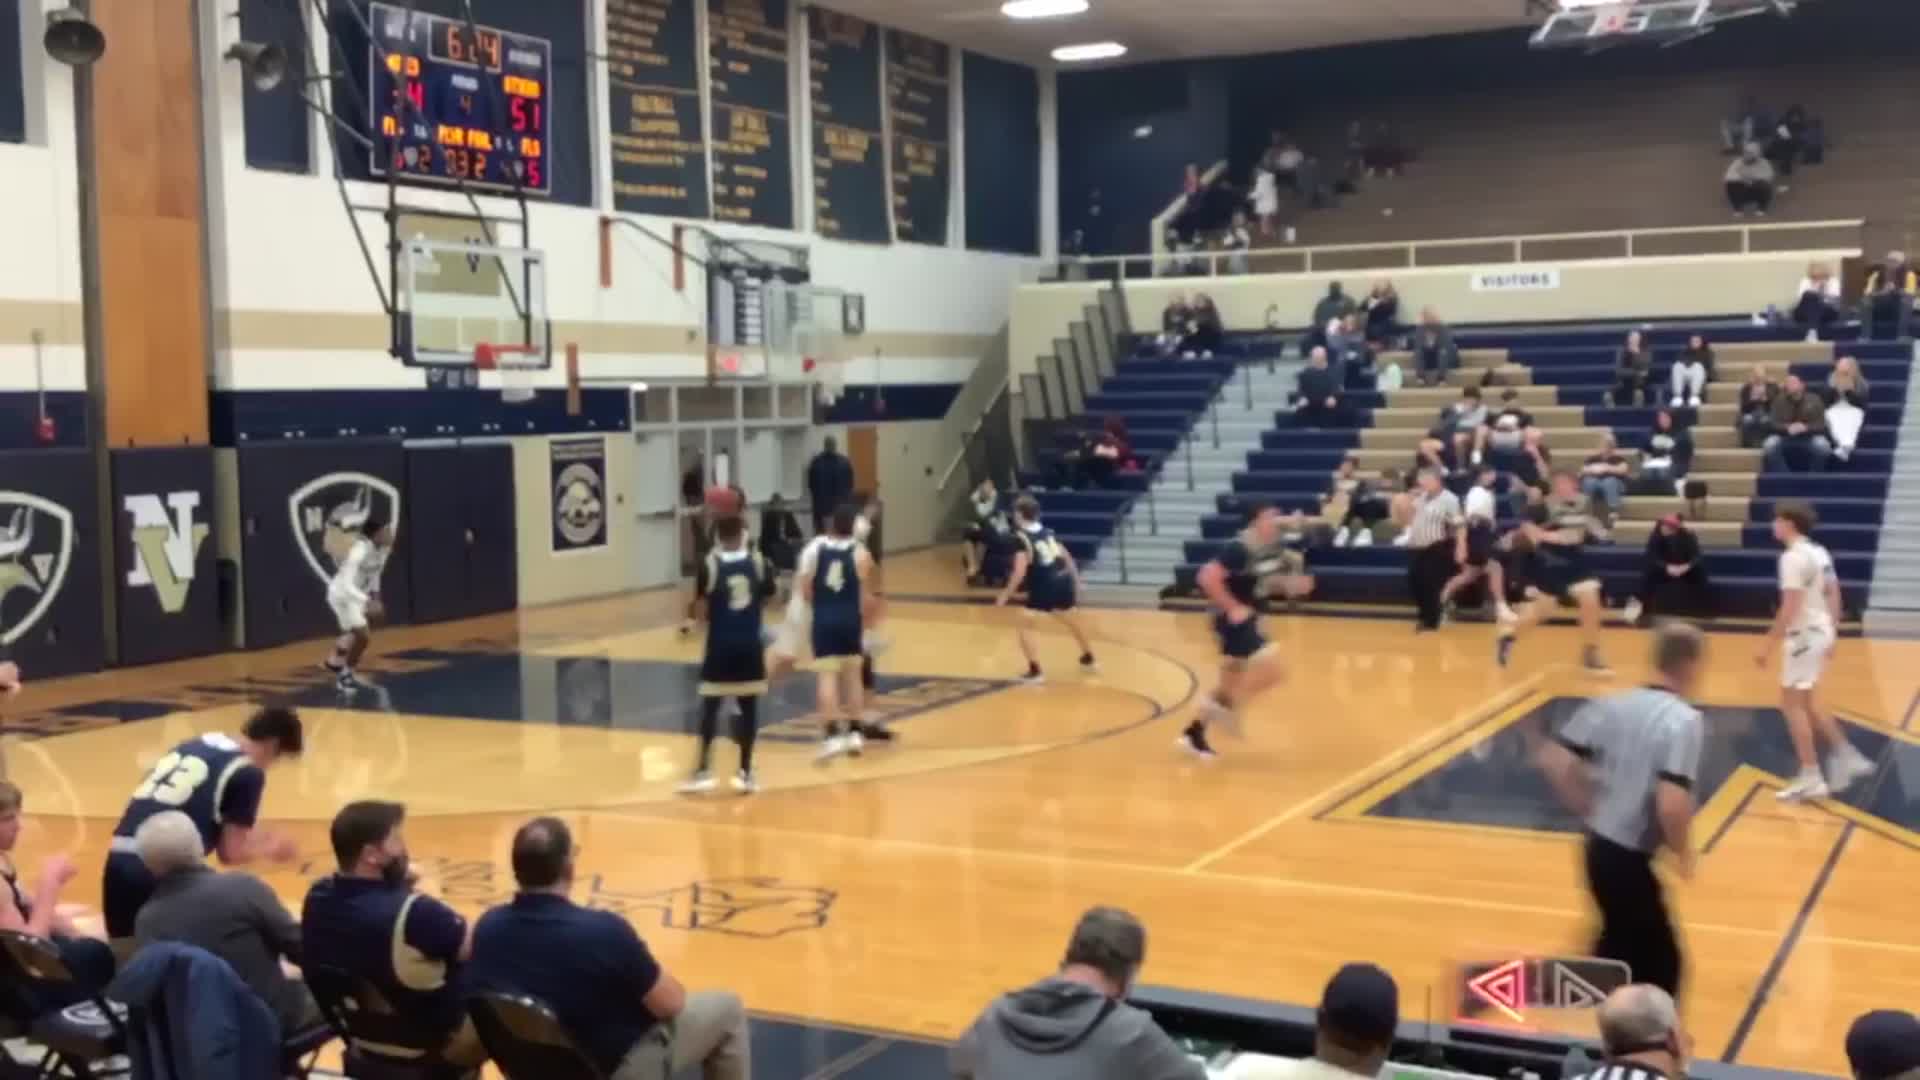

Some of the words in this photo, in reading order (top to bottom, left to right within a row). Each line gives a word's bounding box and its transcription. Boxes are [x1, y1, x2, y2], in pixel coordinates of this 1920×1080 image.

[511, 97, 541, 131] 51
[526, 160, 541, 187] 5
[825, 560, 845, 593] 4
